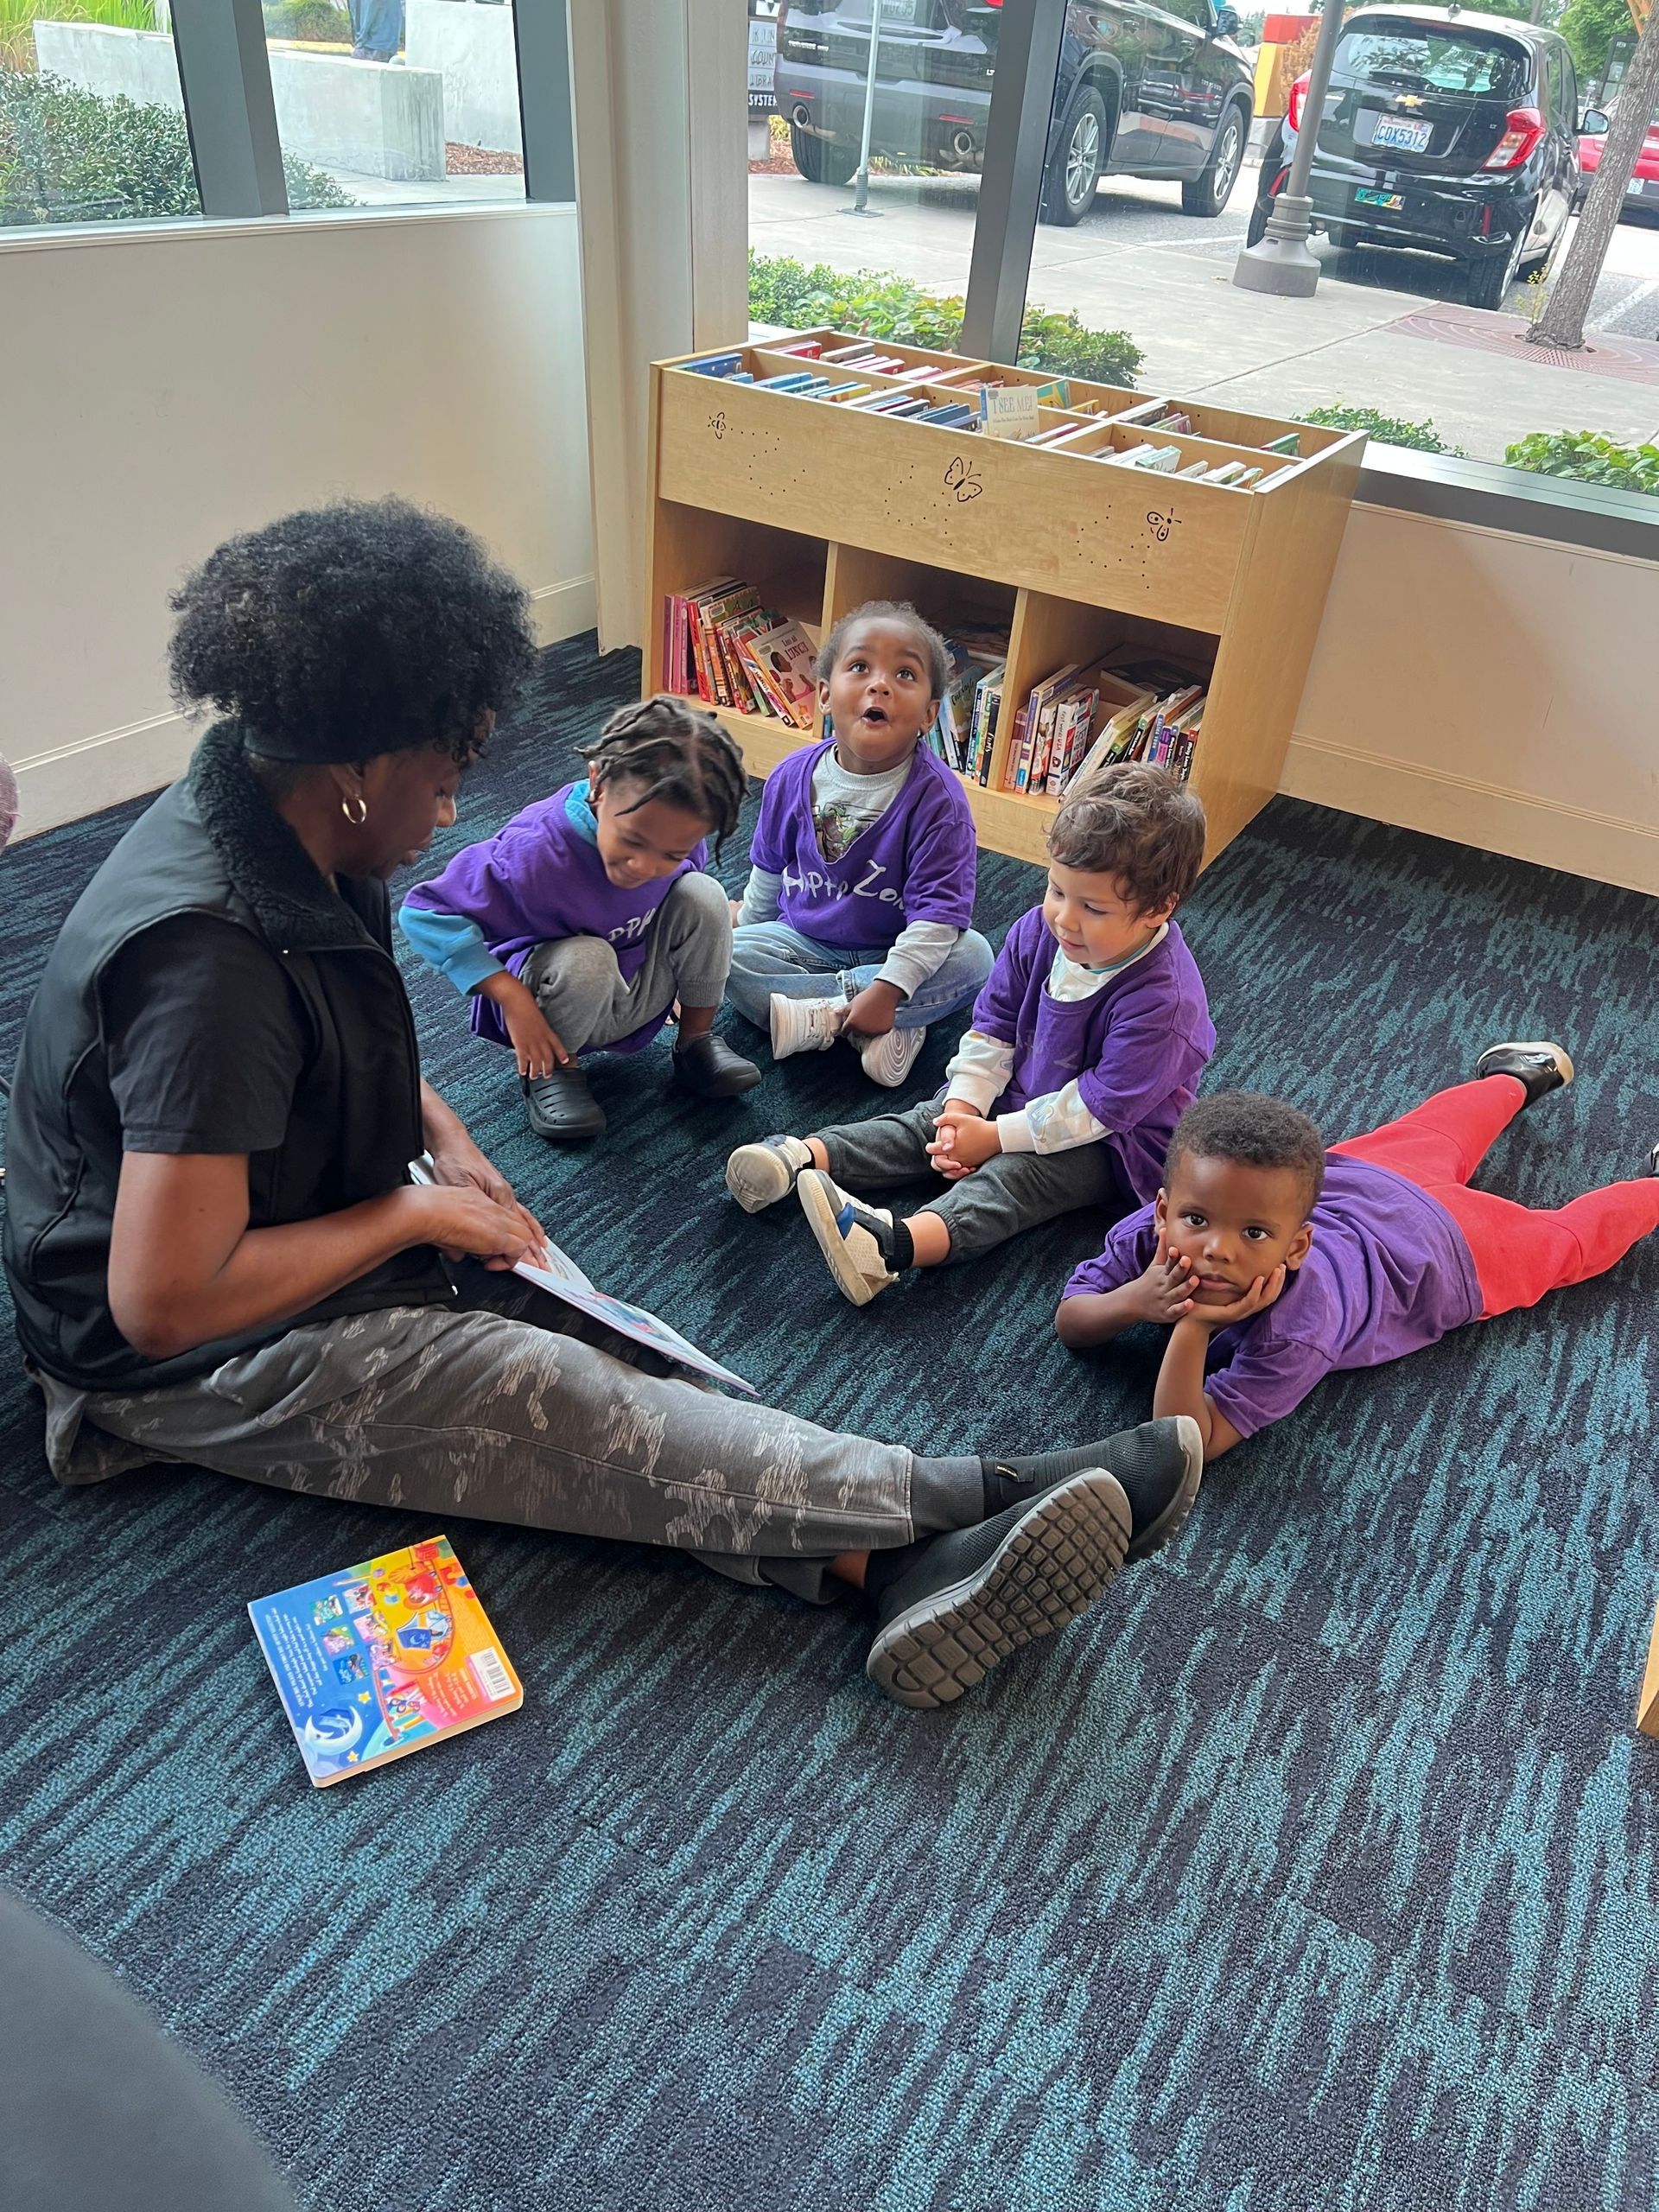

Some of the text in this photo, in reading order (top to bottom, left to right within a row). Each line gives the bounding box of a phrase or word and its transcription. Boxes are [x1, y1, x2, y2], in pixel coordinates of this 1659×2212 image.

[752, 27, 776, 43] KIN
[750, 50, 775, 66] COUN
[749, 74, 773, 86] LIBRA
[999, 397, 1015, 414] SEE
[852, 859, 906, 910] Zon
